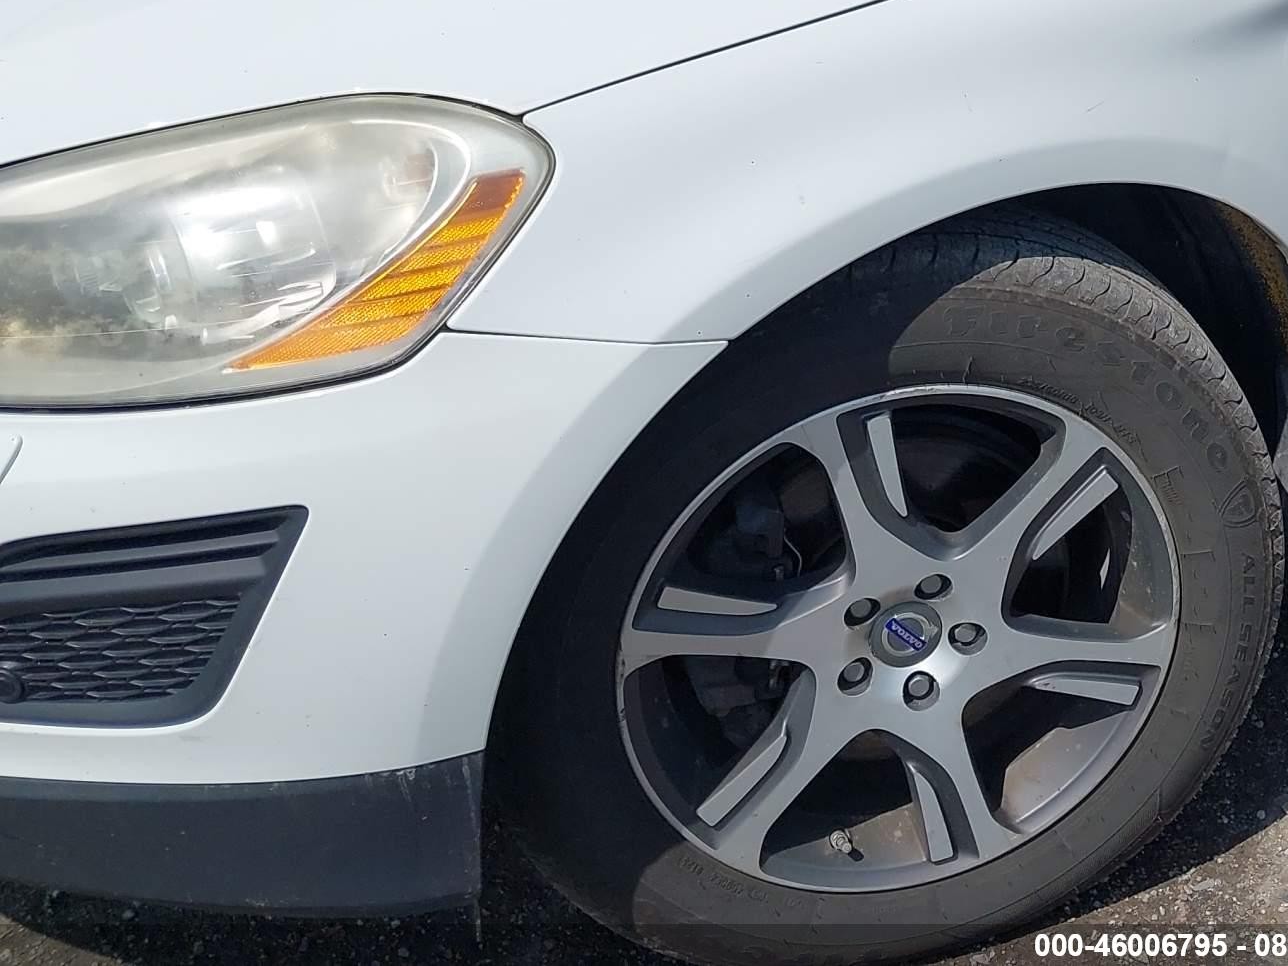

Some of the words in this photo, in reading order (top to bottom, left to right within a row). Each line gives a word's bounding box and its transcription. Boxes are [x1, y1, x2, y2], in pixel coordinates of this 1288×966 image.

[1241, 552, 1257, 614] ALL
[890, 621, 925, 649] VOLVO
[1200, 622, 1253, 751] SEASON
